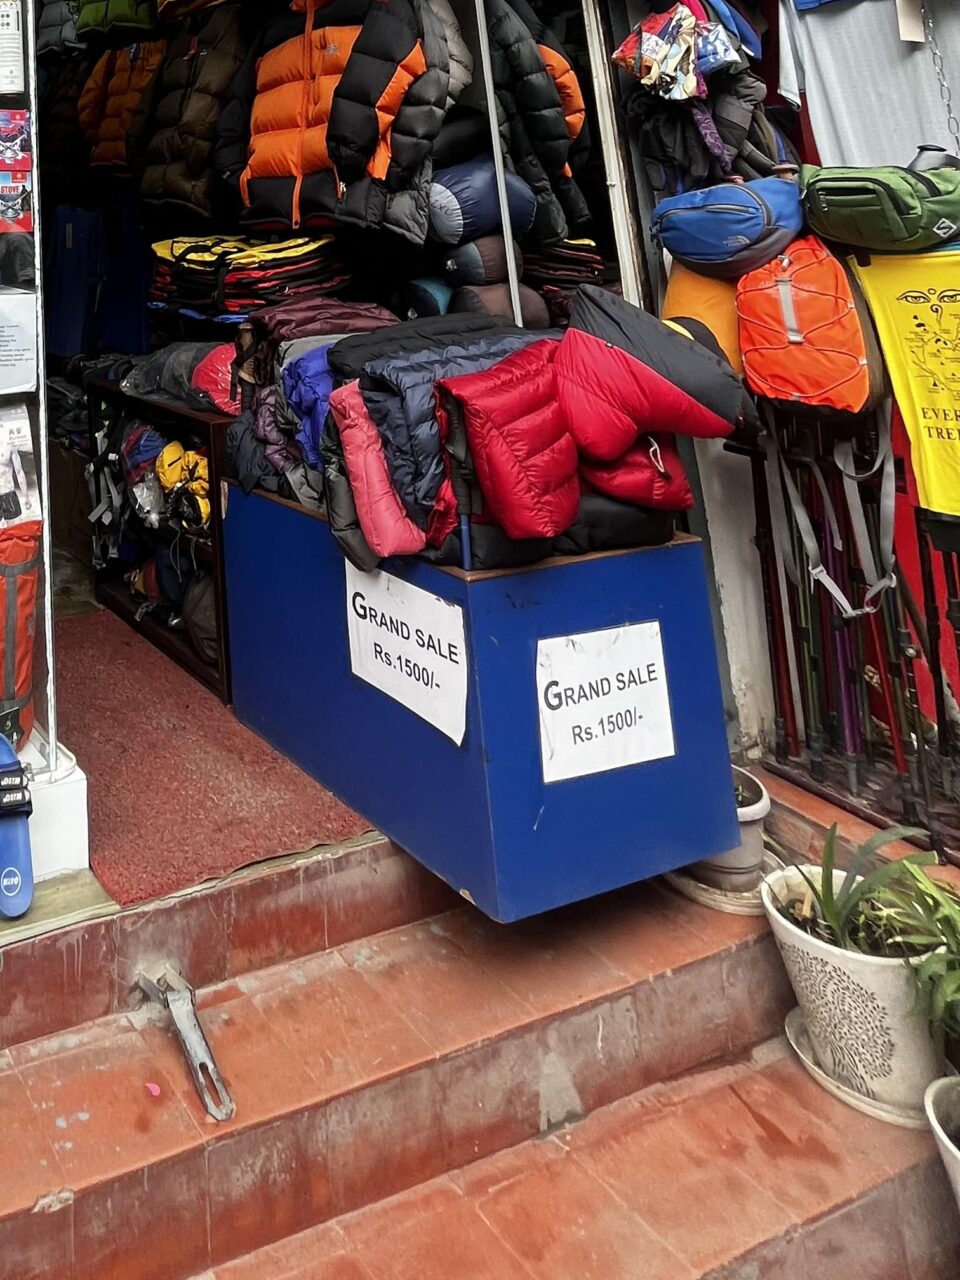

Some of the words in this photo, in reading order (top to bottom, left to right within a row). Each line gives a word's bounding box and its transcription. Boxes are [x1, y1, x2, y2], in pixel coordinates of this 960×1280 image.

[0, 185, 20, 194] STOVE
[352, 591, 410, 641] GRAND
[415, 628, 460, 665] SALE
[373, 642, 441, 689] Rs.1500/-
[543, 680, 611, 711] GRAND
[615, 662, 658, 691] SALE
[572, 706, 643, 745] Rs.1500/-
